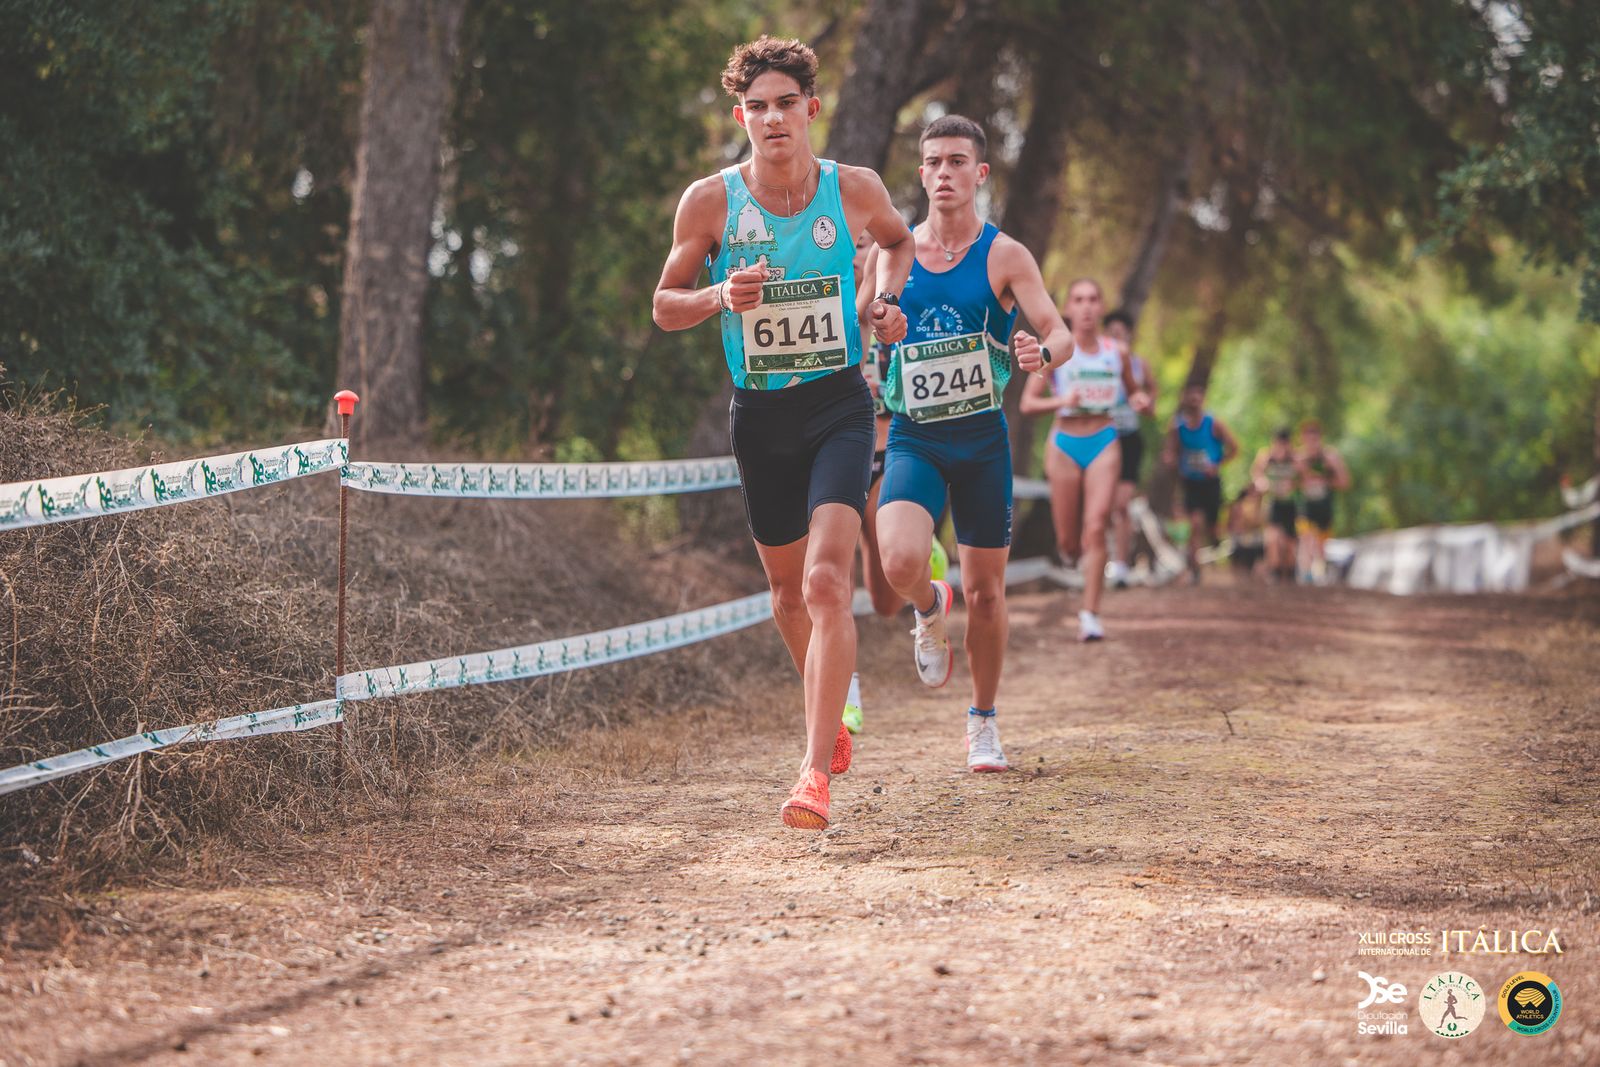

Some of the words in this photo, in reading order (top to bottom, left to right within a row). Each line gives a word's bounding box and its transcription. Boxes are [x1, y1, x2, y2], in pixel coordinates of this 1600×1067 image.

[770, 283, 818, 297] ITÁLICA
[754, 312, 838, 347] 6141
[922, 340, 964, 356] ITÁLICA
[912, 364, 986, 400] 8244
